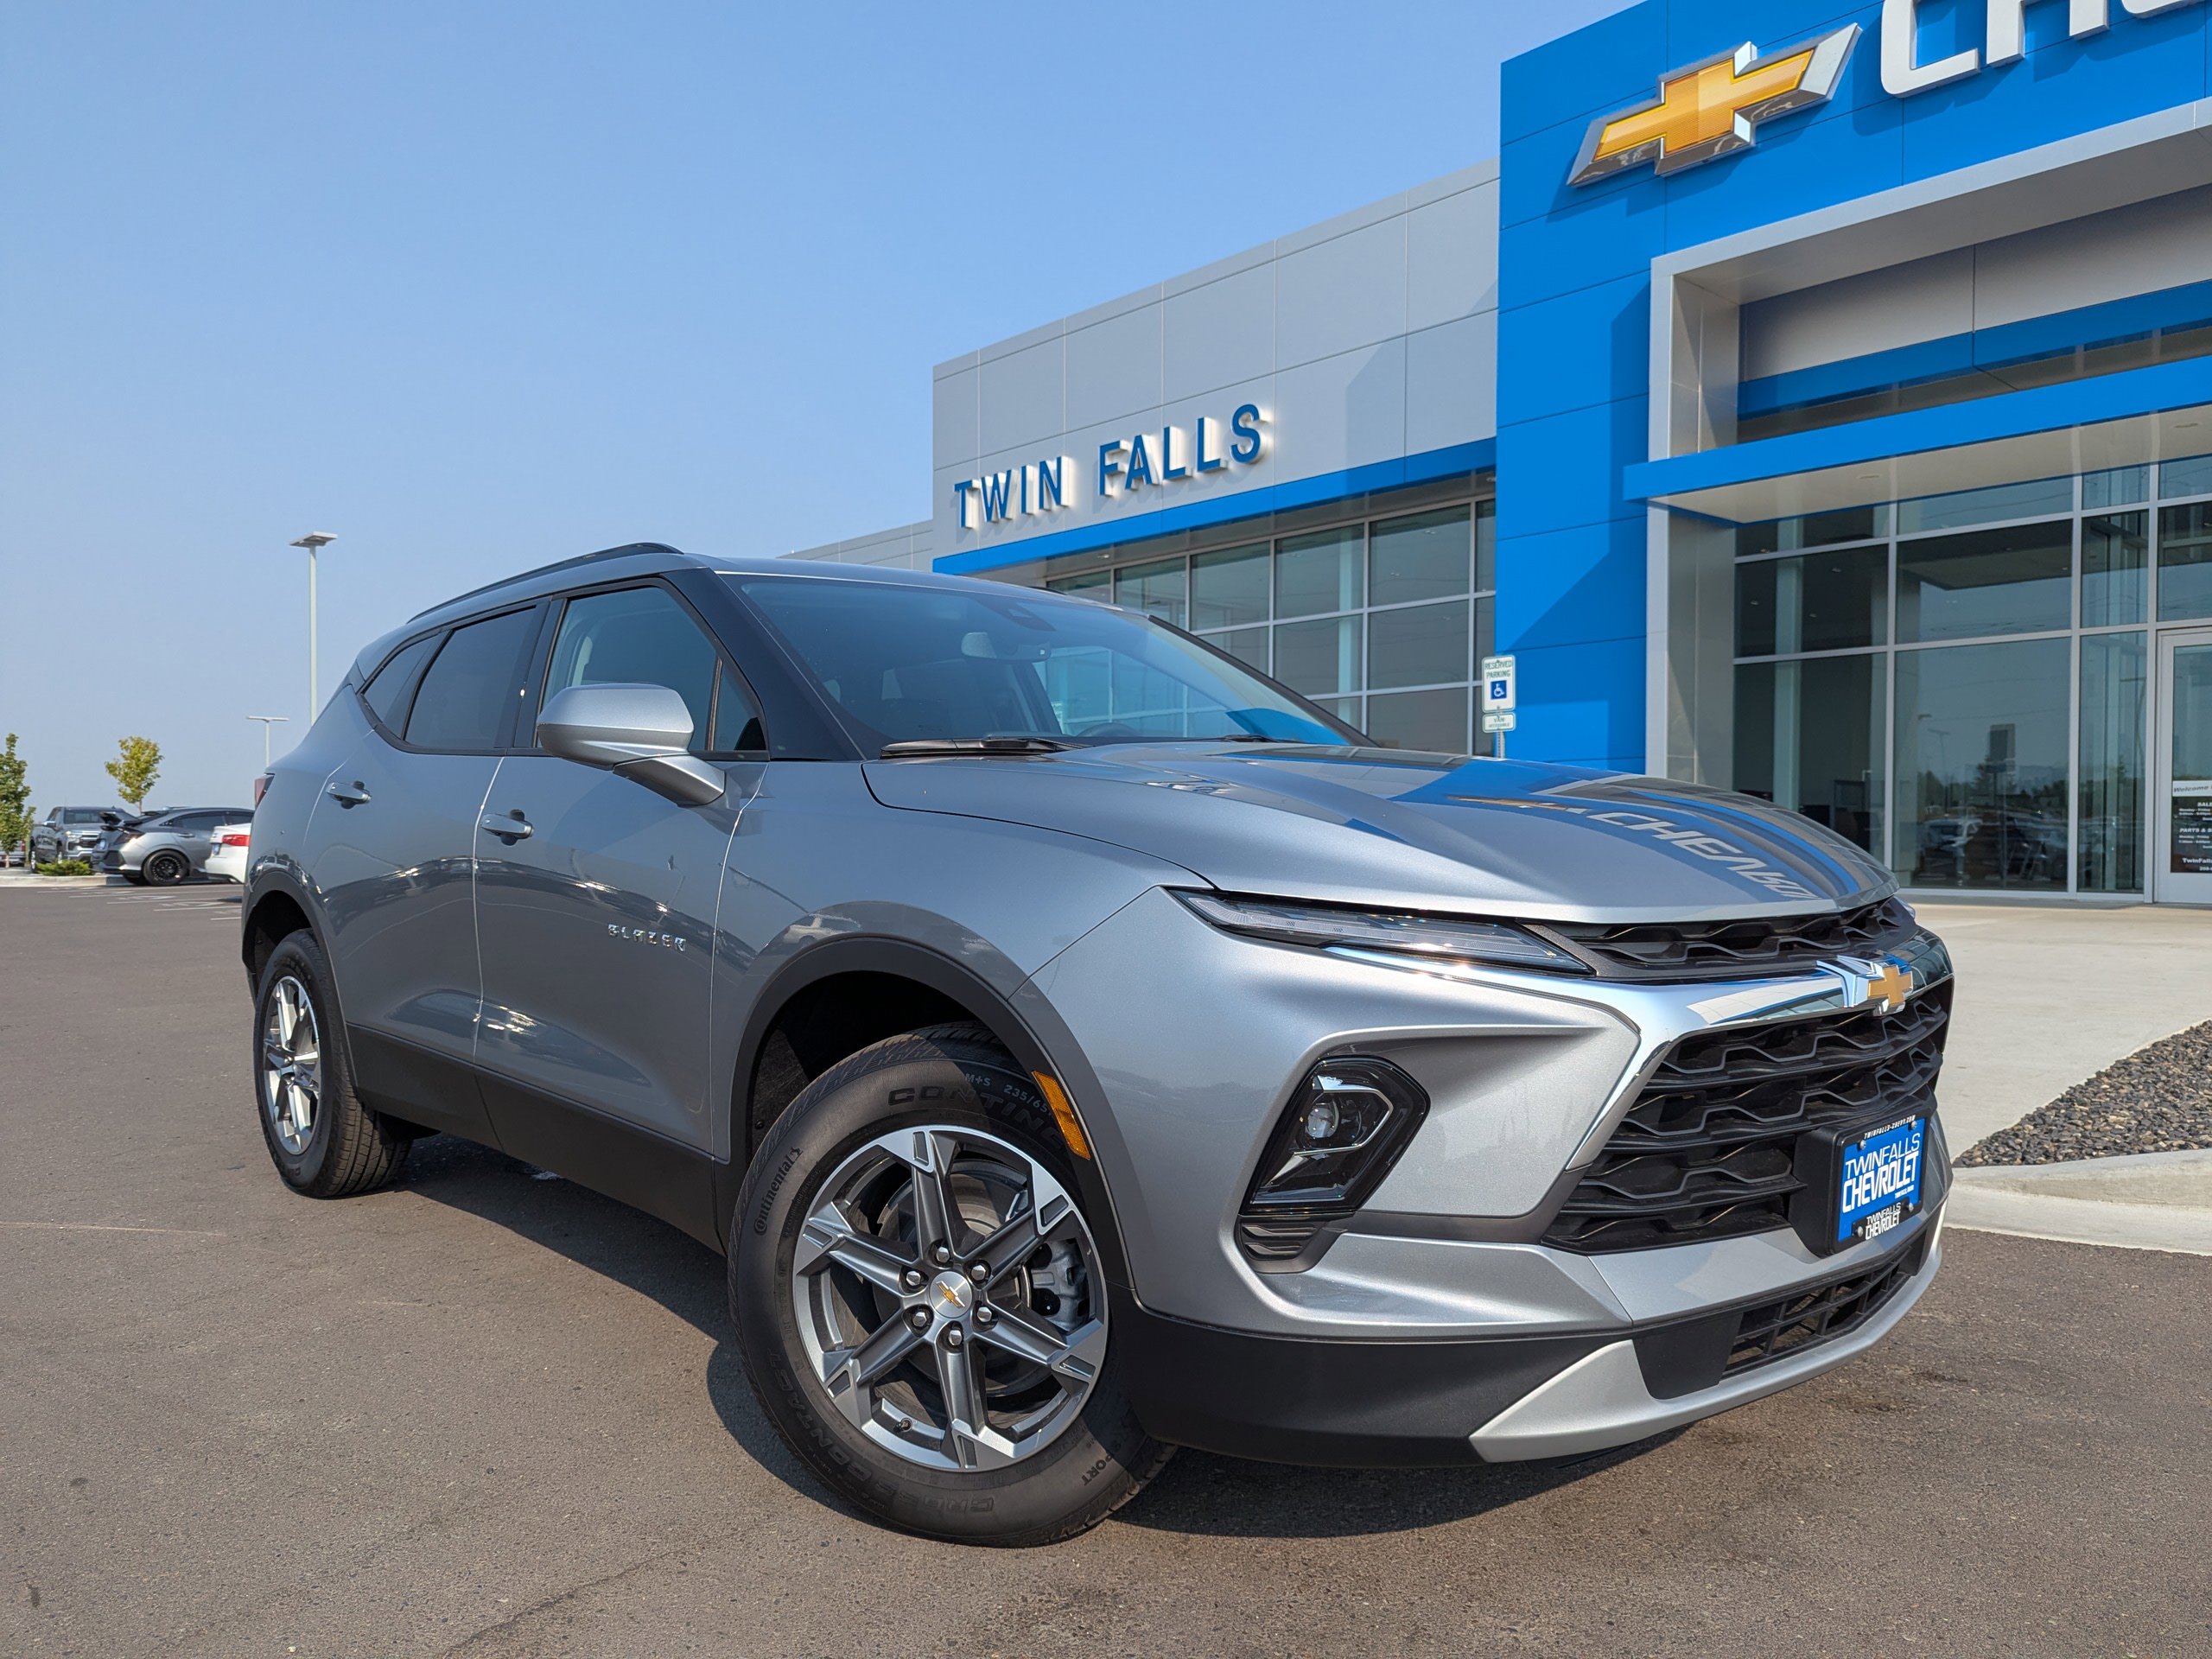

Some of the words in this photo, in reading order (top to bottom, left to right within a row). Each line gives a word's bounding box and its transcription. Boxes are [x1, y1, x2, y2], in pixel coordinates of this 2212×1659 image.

[954, 456, 1069, 529] TWIN
[1097, 404, 1266, 497] FALLS
[1484, 660, 1513, 670] RESERVED
[607, 924, 686, 951] BLAZER
[1003, 1084, 1052, 1116] 235/65
[1845, 1133, 1921, 1179] TWINFALLS
[754, 1154, 794, 1236] Continental
[1842, 1151, 1919, 1213] CHEVROLET
[1865, 1211, 1901, 1240] CHEVROLET
[1866, 1203, 1901, 1224] TWINFALLS
